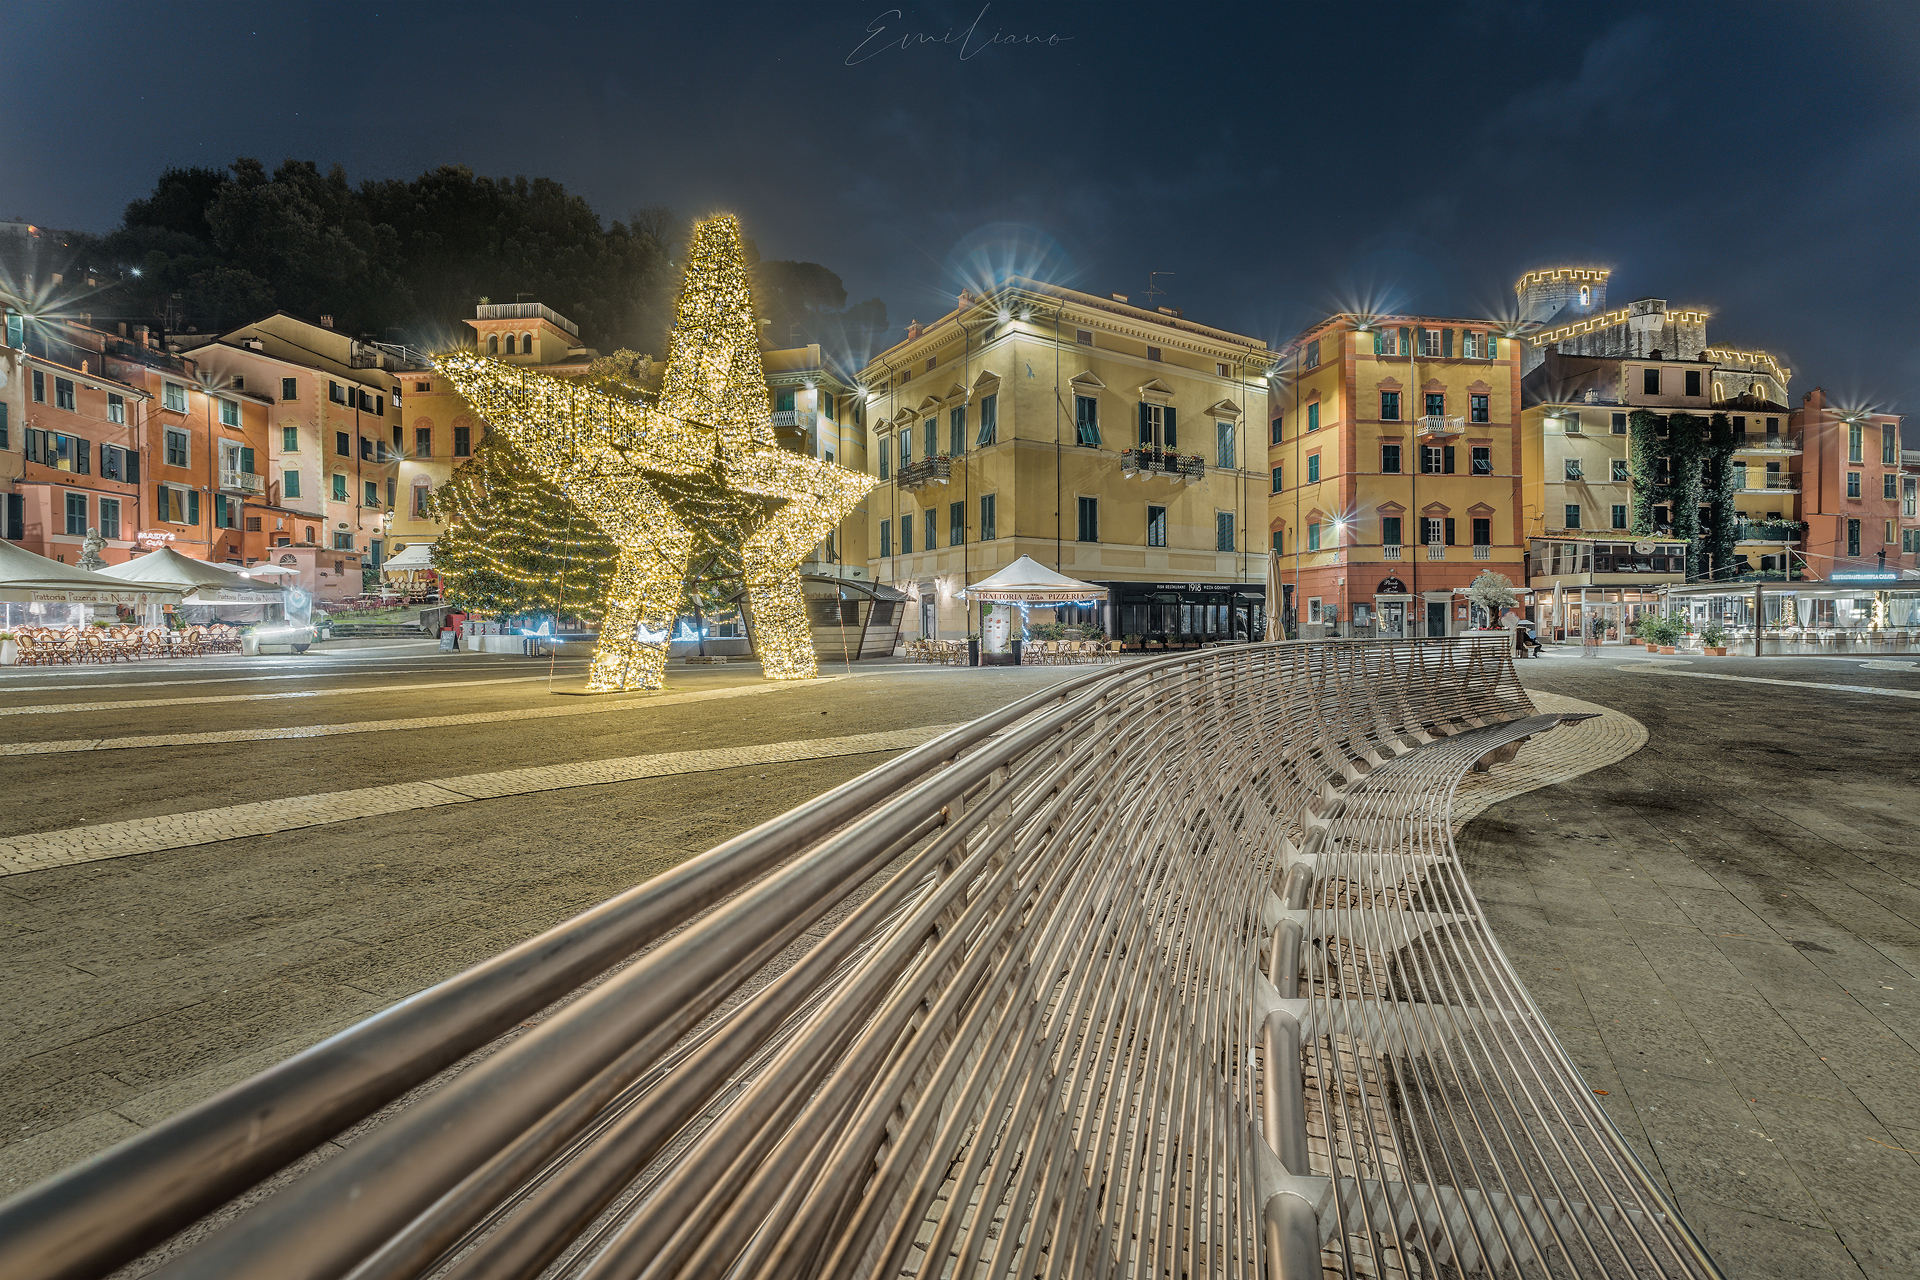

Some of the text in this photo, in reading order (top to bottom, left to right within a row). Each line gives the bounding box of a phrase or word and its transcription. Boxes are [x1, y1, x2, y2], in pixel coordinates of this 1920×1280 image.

[1188, 583, 1202, 592] 1918
[31, 590, 136, 603] Trattoria Pizzeria da Nicola
